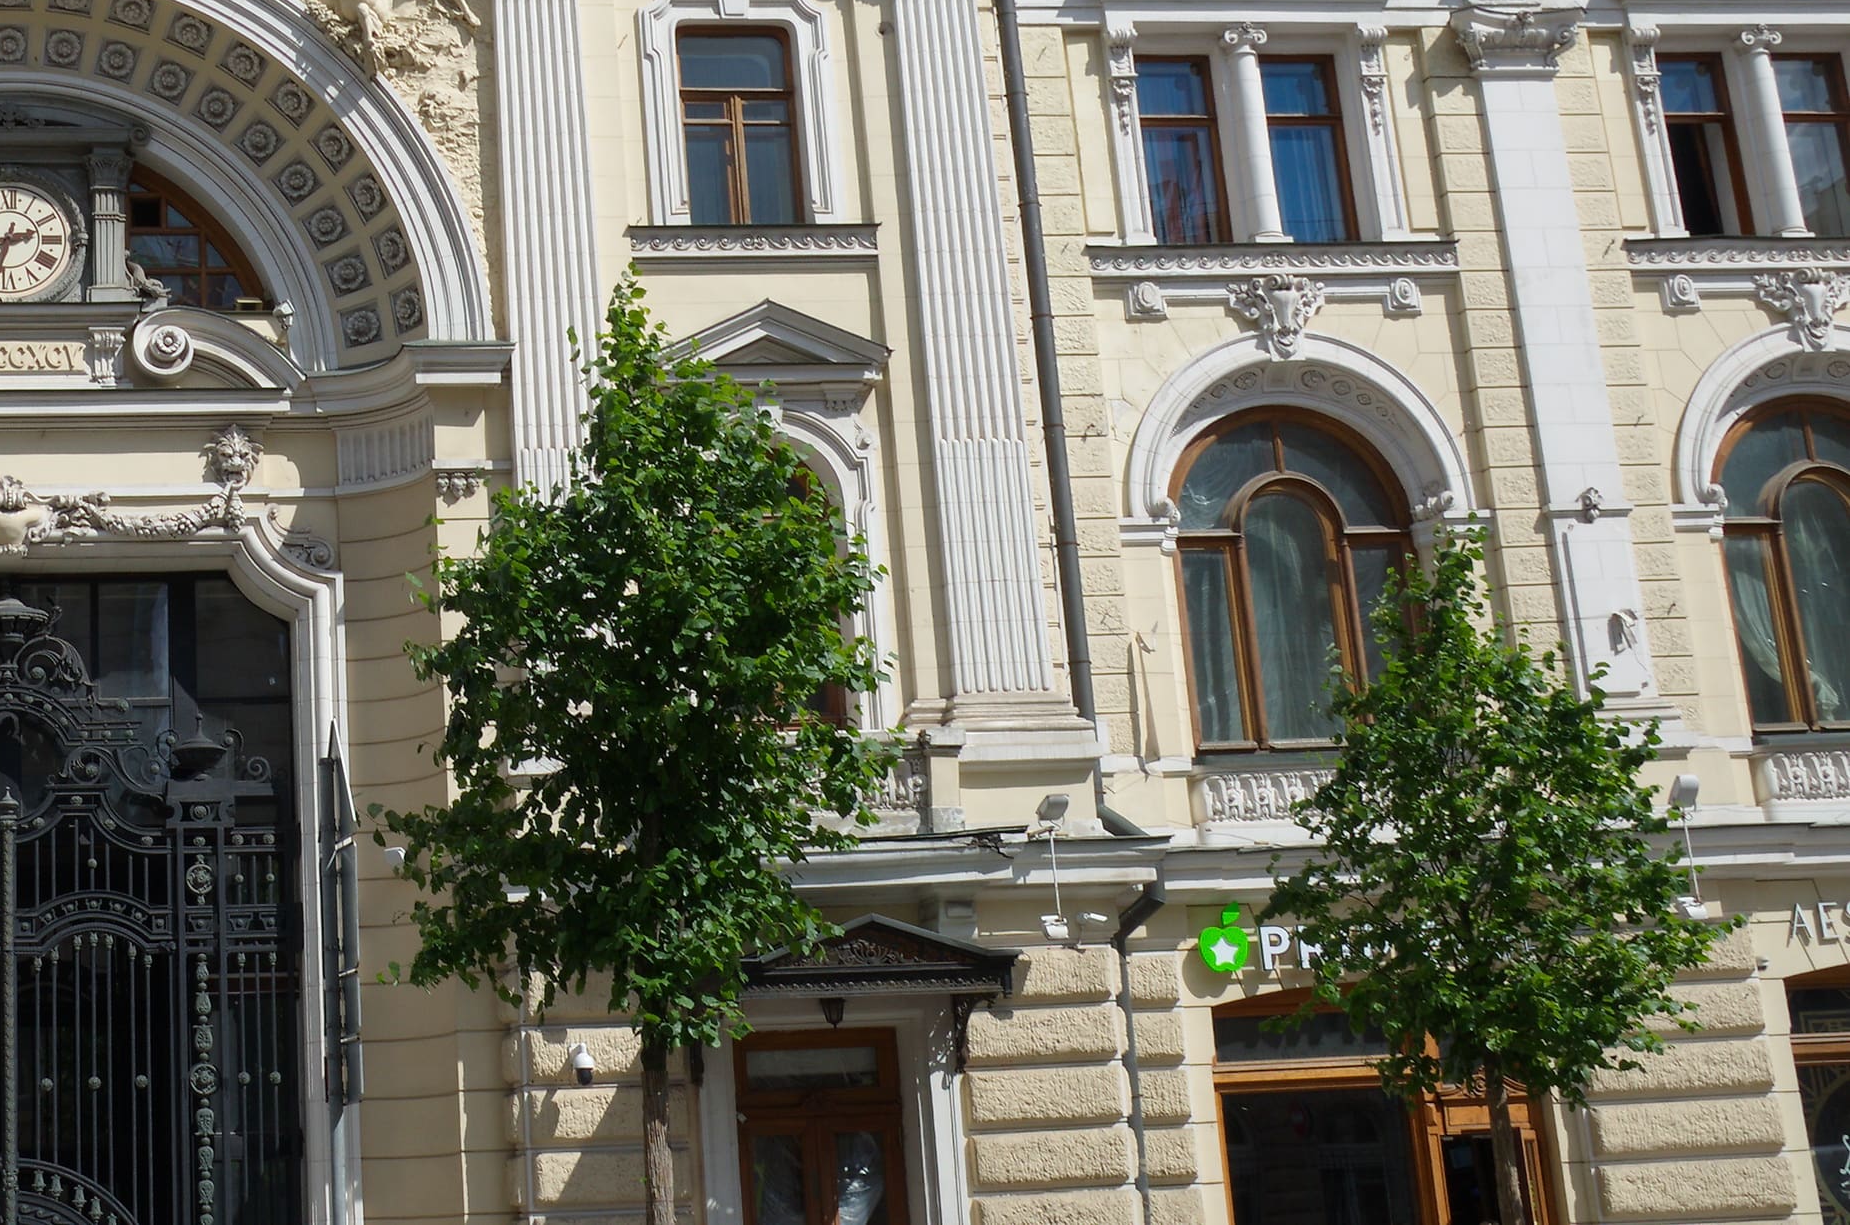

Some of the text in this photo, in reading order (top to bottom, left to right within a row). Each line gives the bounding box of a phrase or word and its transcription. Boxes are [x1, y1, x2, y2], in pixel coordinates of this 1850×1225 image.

[0, 190, 17, 210] XII
[24, 196, 37, 214] I
[36, 212, 57, 227] II
[41, 235, 62, 245] III
[1, 267, 16, 290] VI
[25, 267, 40, 285] V
[1793, 902, 1850, 940] AE
